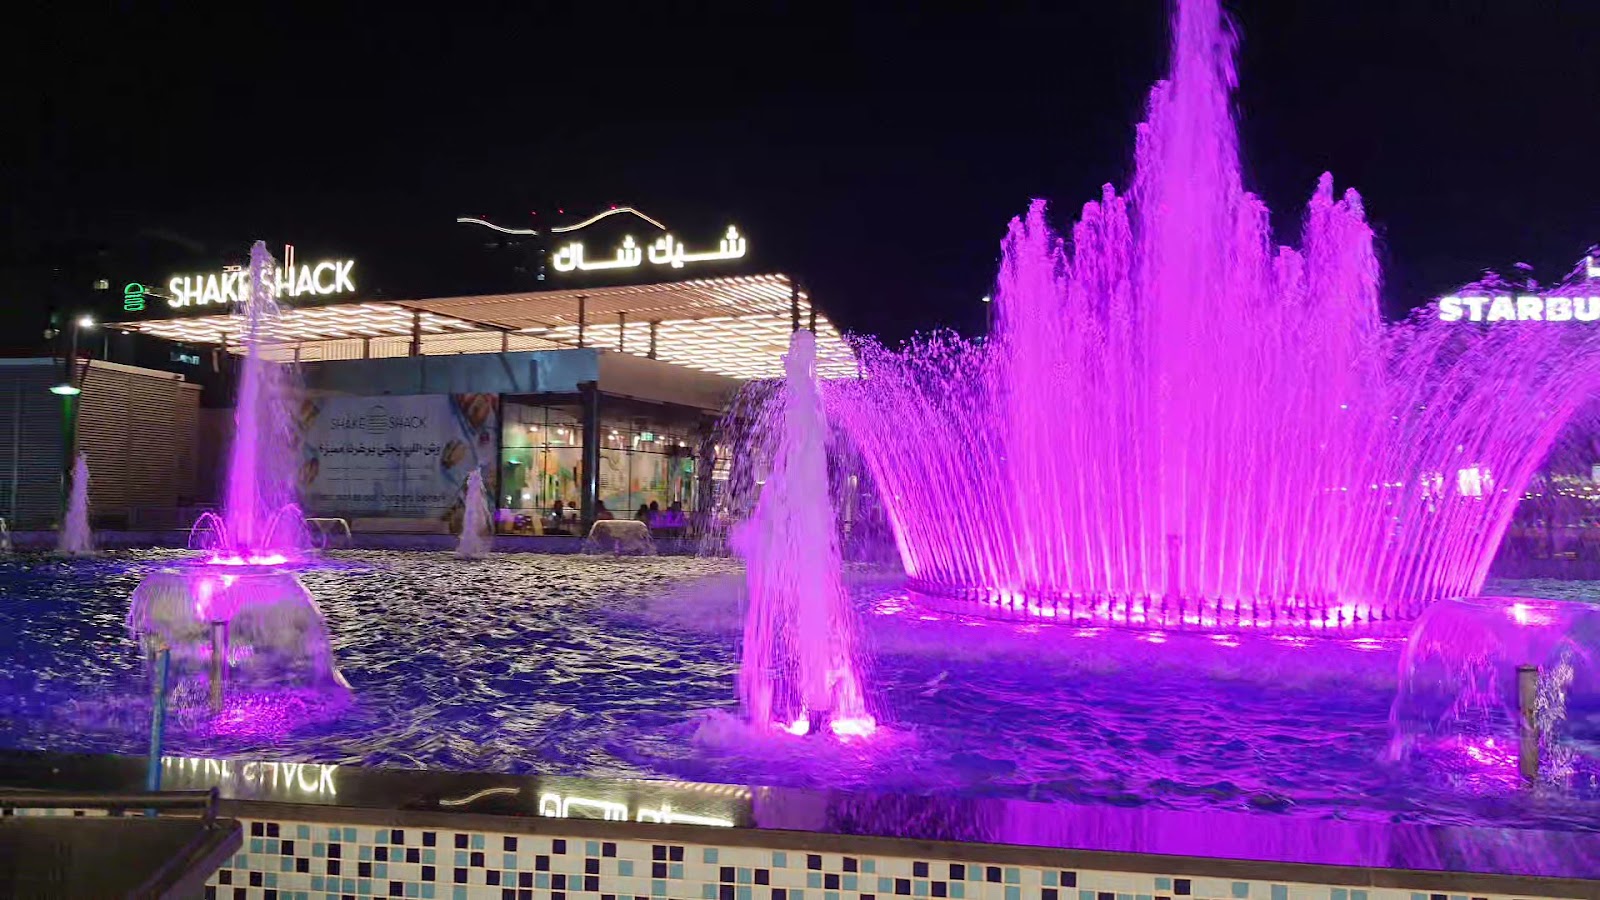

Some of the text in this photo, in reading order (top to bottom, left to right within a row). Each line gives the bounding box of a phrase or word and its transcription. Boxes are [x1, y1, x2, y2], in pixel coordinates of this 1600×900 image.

[552, 225, 746, 272] شيك شاك
[258, 260, 355, 301] SHACK
[331, 416, 428, 430] SHAKE SHACK
